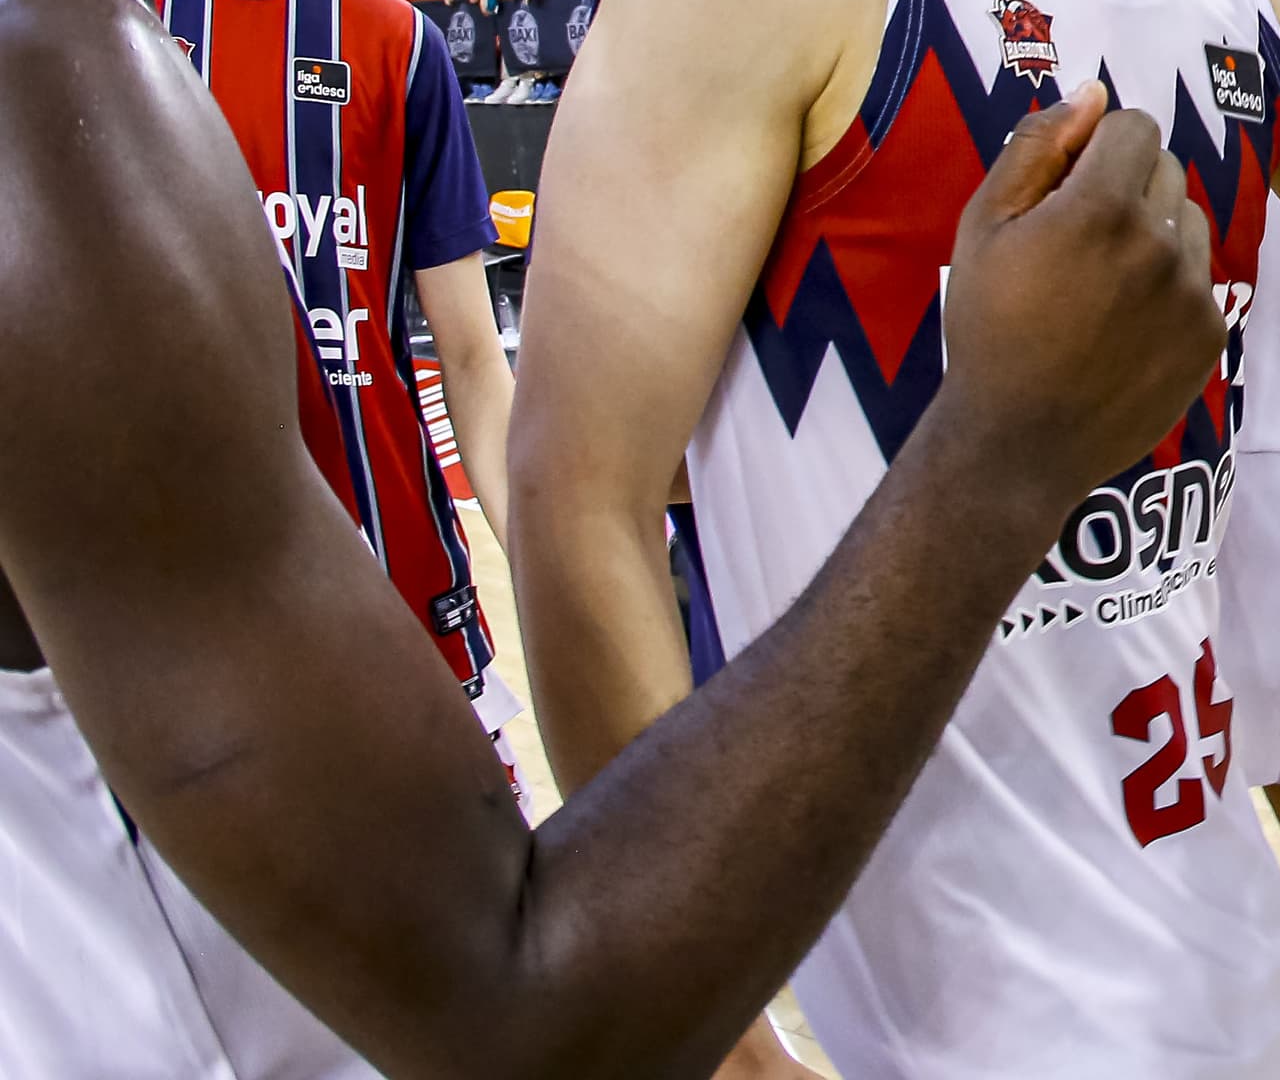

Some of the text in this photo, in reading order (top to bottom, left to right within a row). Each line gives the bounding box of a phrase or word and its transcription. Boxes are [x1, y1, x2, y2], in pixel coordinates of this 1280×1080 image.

[569, 24, 588, 41] BA
[297, 69, 320, 84] liga
[1211, 61, 1236, 88] liga
[297, 83, 346, 99] endesa
[1216, 87, 1262, 112] endesa
[256, 184, 369, 258] oyal
[1110, 635, 1235, 850] 25
